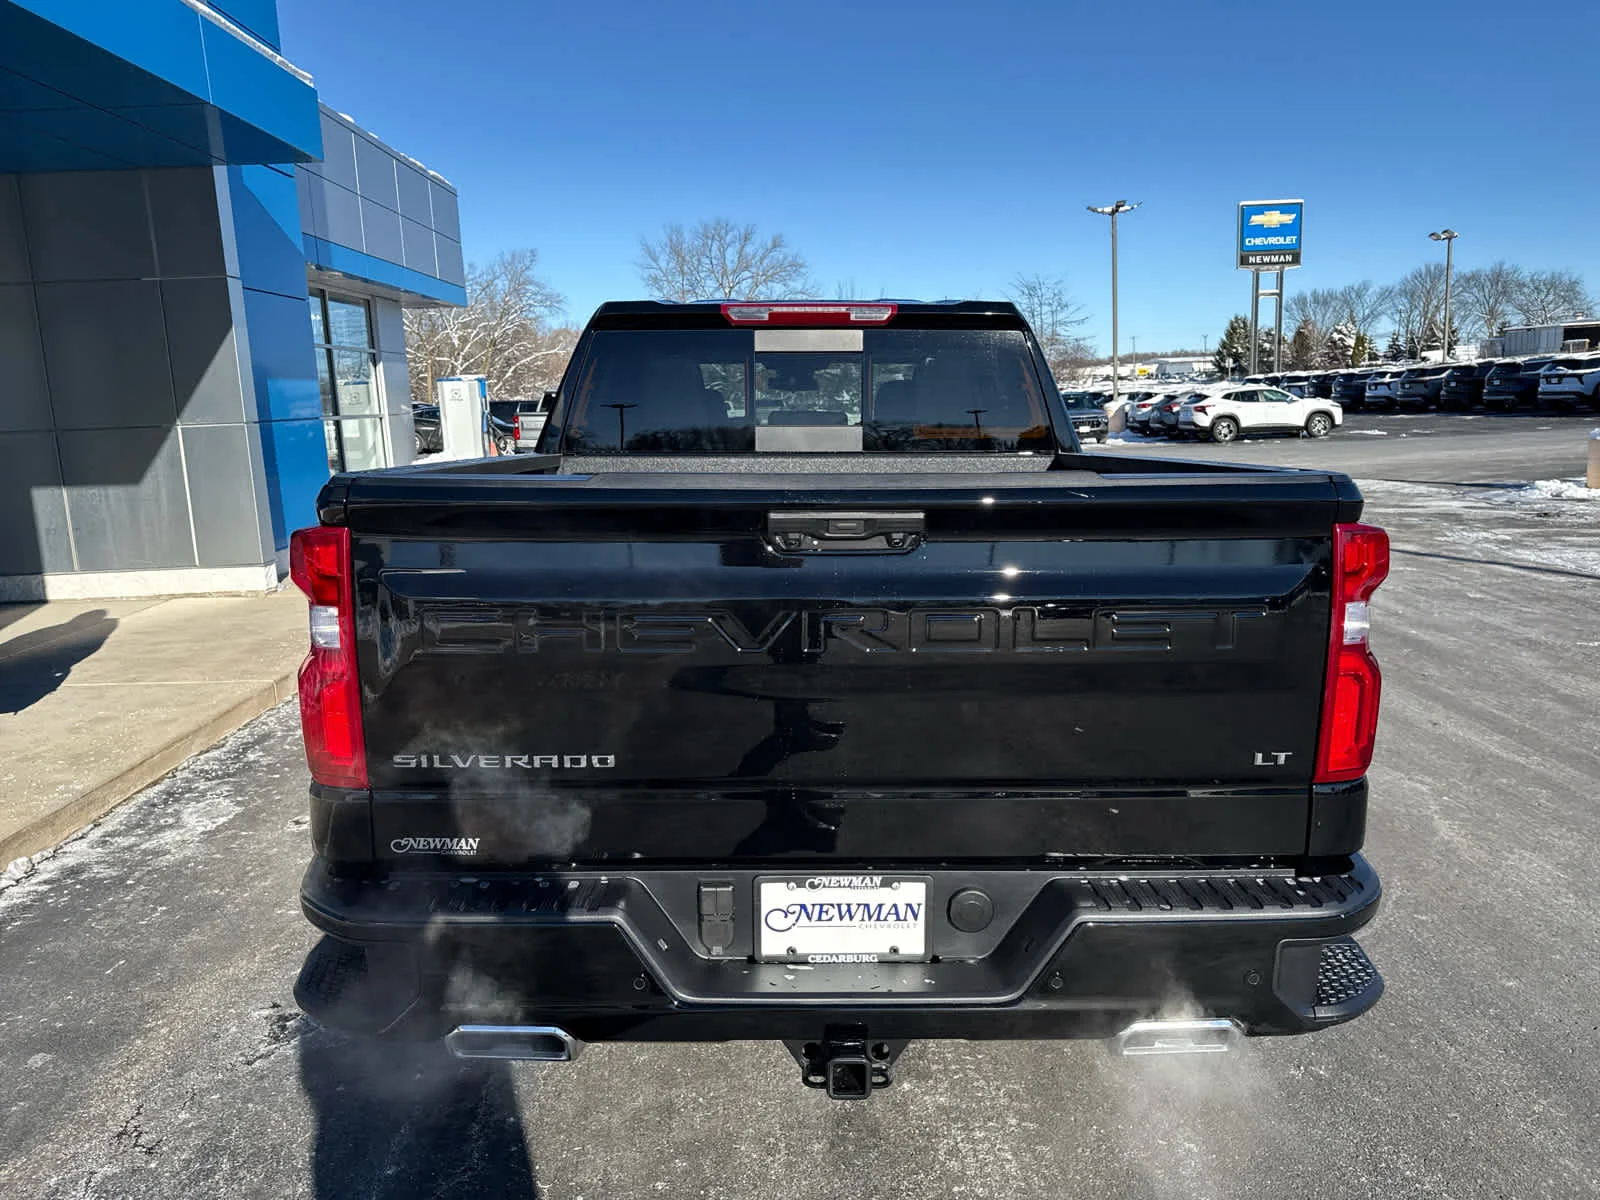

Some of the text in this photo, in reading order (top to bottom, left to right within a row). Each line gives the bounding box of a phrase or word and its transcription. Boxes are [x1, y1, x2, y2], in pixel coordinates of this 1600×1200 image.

[1245, 236, 1297, 246] CHEVROLET
[1248, 254, 1292, 264] NEWMAN
[421, 607, 1268, 654] CHEVROLET
[393, 754, 615, 768] SILVERADO
[1254, 752, 1293, 766] LT
[391, 837, 480, 853] NEWMAN
[805, 876, 883, 891] NEWMAN
[764, 903, 922, 932] NEWMAN
[807, 954, 879, 963] CEDARBURG
